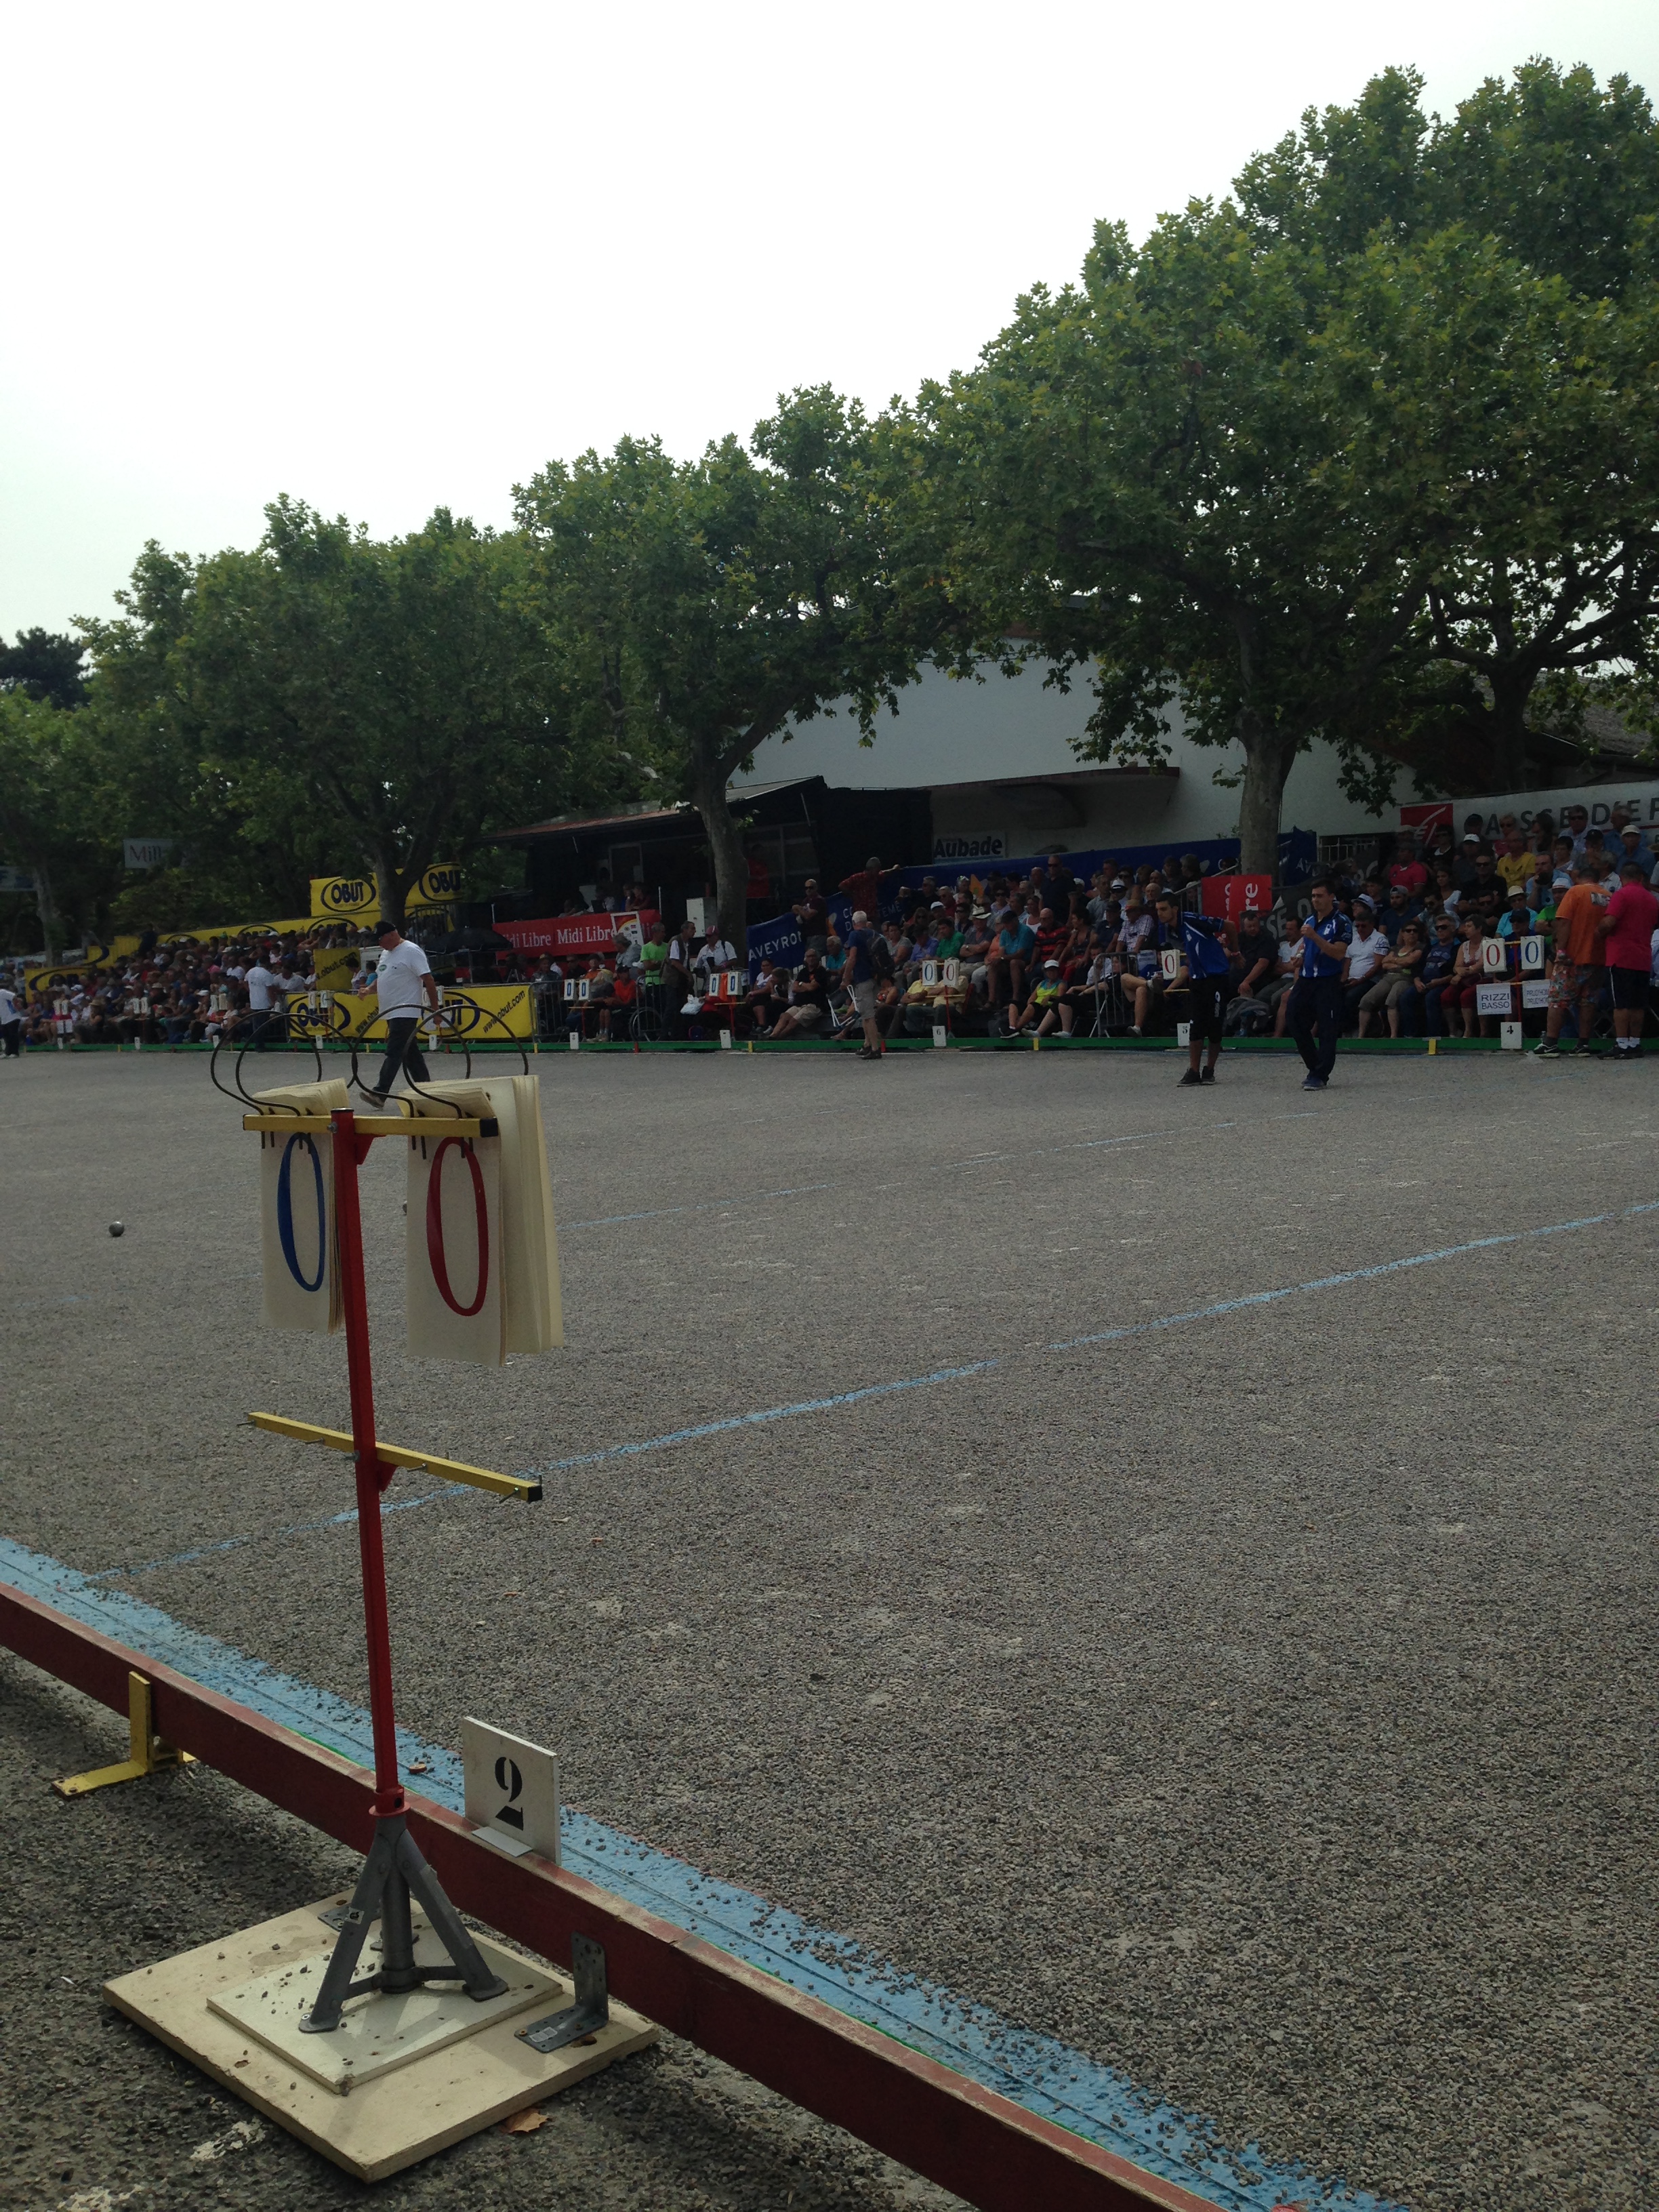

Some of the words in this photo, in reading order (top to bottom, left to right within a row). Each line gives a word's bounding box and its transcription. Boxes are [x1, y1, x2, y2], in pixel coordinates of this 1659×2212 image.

[129, 844, 162, 862] Mill
[934, 836, 1003, 858] Aubade
[428, 869, 462, 893] OBU
[331, 882, 364, 904] OBUT
[522, 931, 551, 948] Libre
[556, 926, 583, 945] Midi
[586, 923, 615, 942] Libre
[1164, 954, 1174, 974] 0
[1486, 944, 1500, 966] 0
[1525, 941, 1538, 963] 0
[924, 964, 933, 981] 0
[946, 964, 954, 981] 0
[483, 990, 525, 1033] wwwobut.com
[1481, 1001, 1510, 1009] BASSO
[1507, 1025, 1513, 1034] 4
[277, 1132, 325, 1292] 0
[426, 1136, 489, 1317] 0
[495, 1757, 524, 1831] 2
